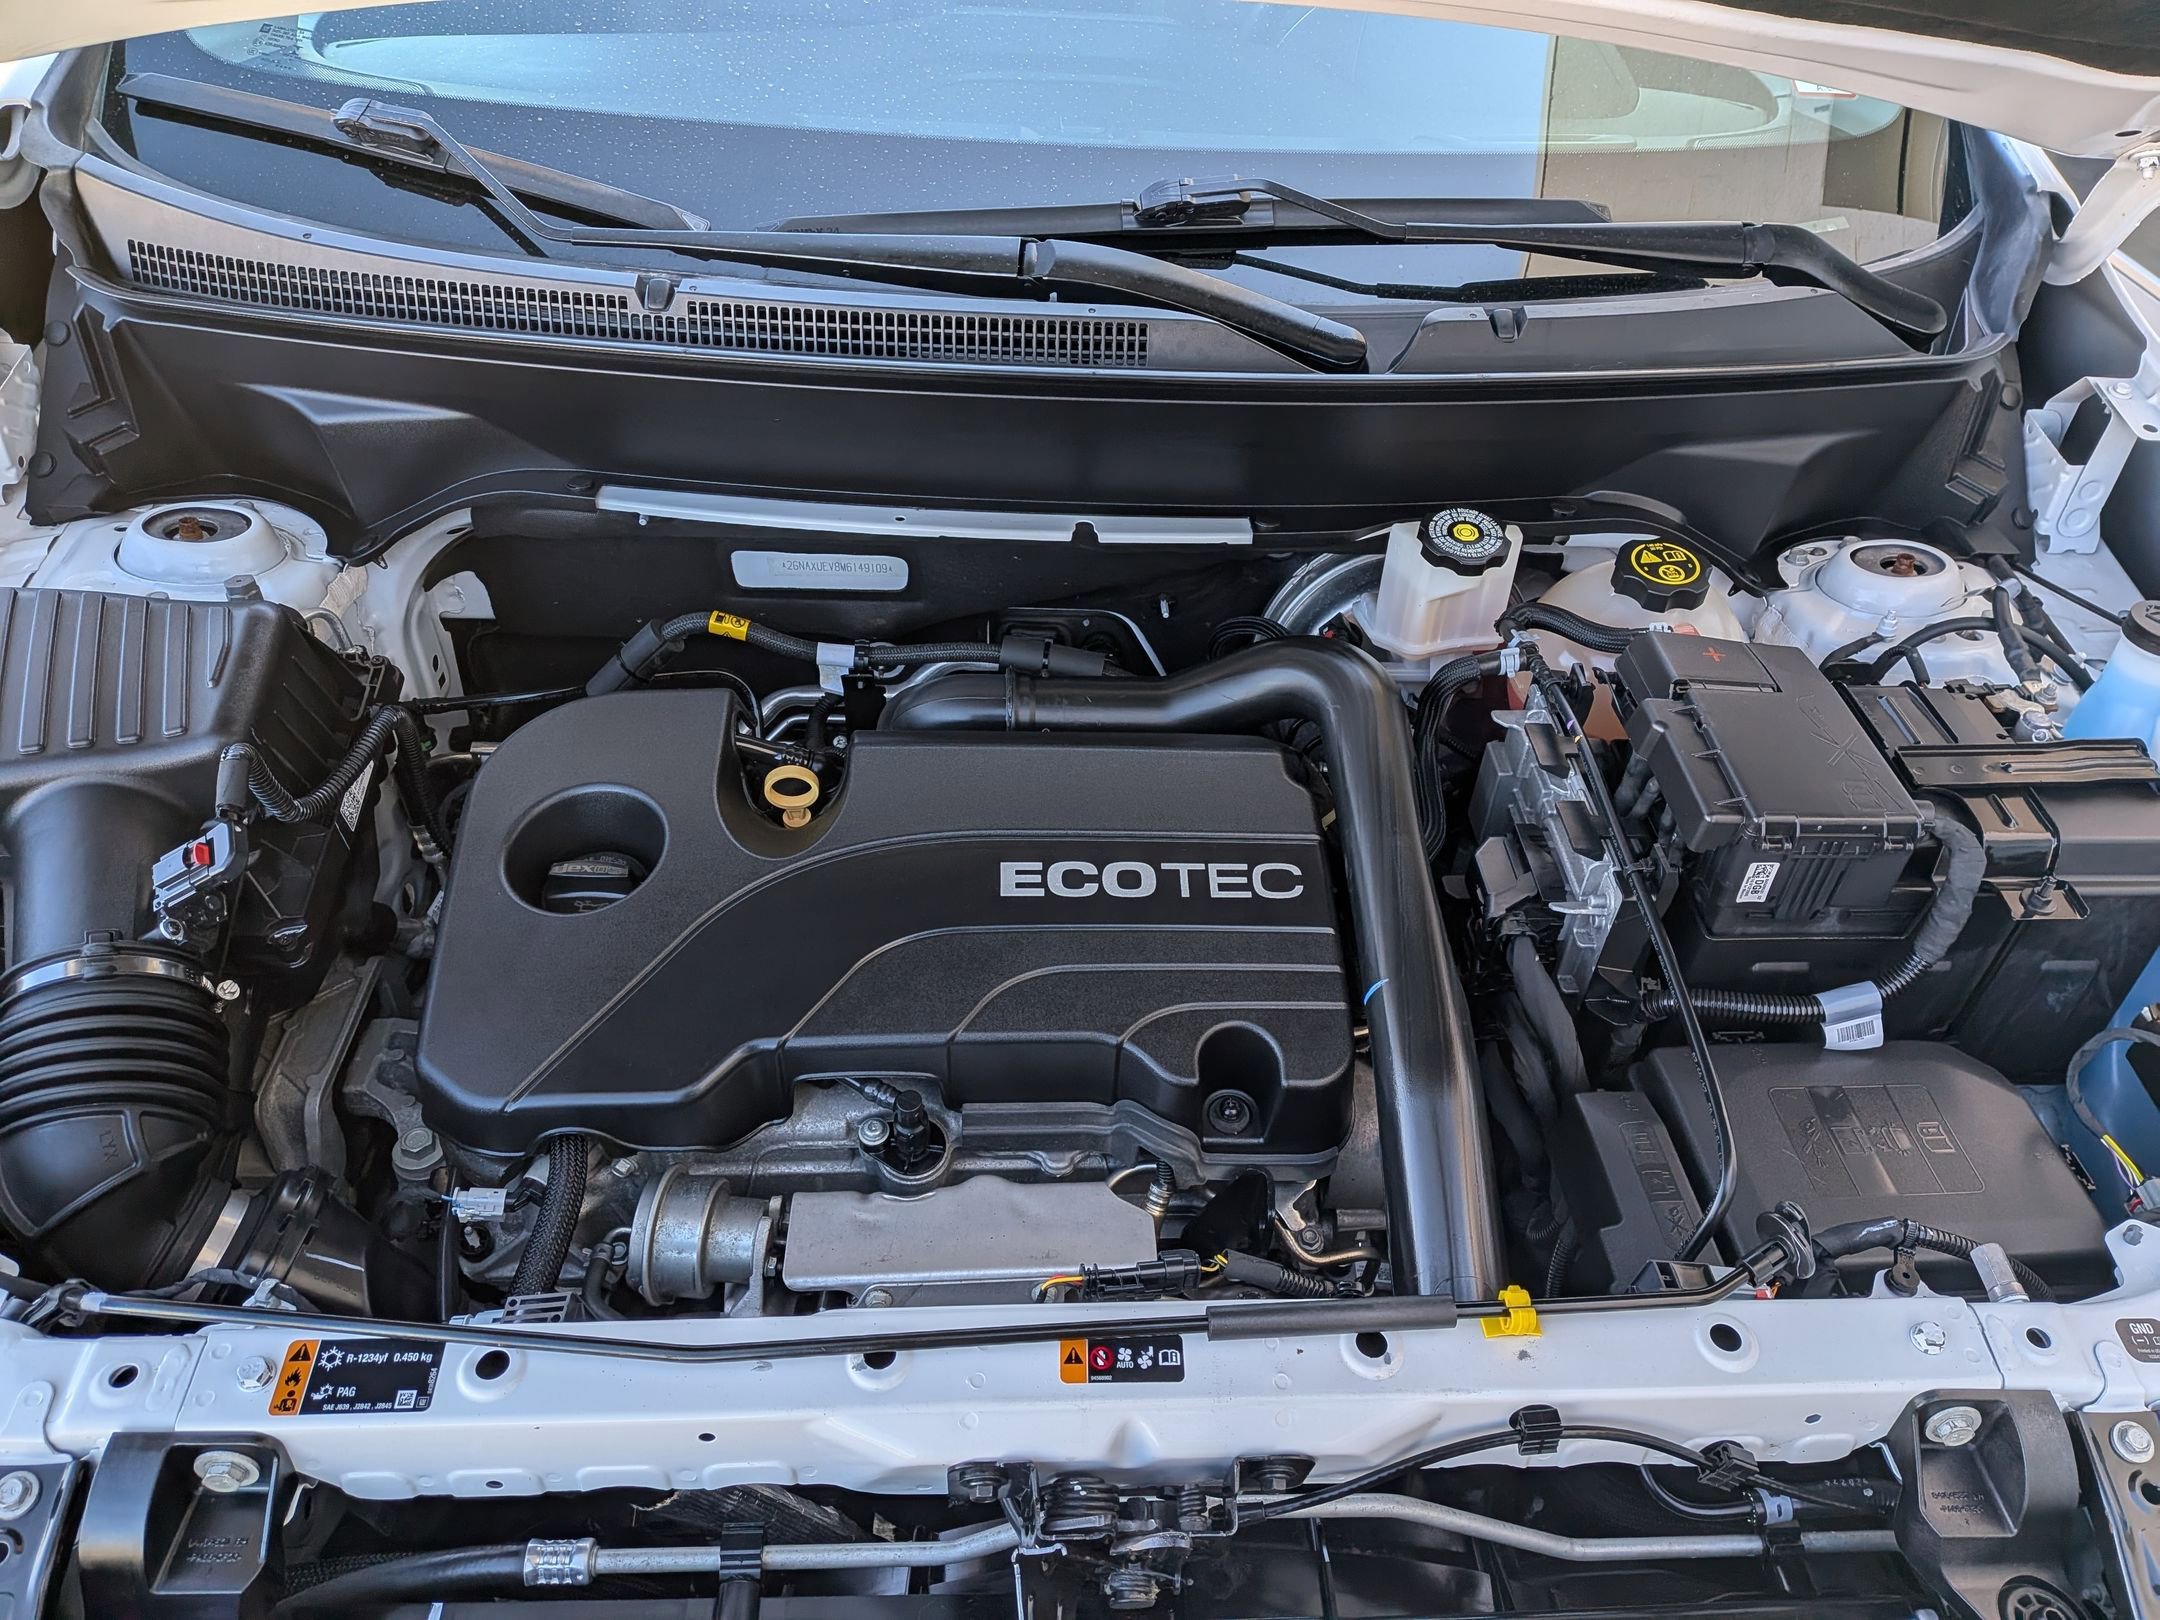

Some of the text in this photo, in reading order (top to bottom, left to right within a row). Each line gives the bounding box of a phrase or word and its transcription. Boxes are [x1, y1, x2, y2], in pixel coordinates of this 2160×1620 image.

[999, 861, 1304, 899] ECOTEC
[2129, 1322, 2154, 1335] GND
[346, 1352, 433, 1364] R-1234yf 0.450 kg
[1116, 1361, 1134, 1369] AUTO
[336, 1386, 357, 1398] PAG
[322, 1403, 335, 1411] SAE
